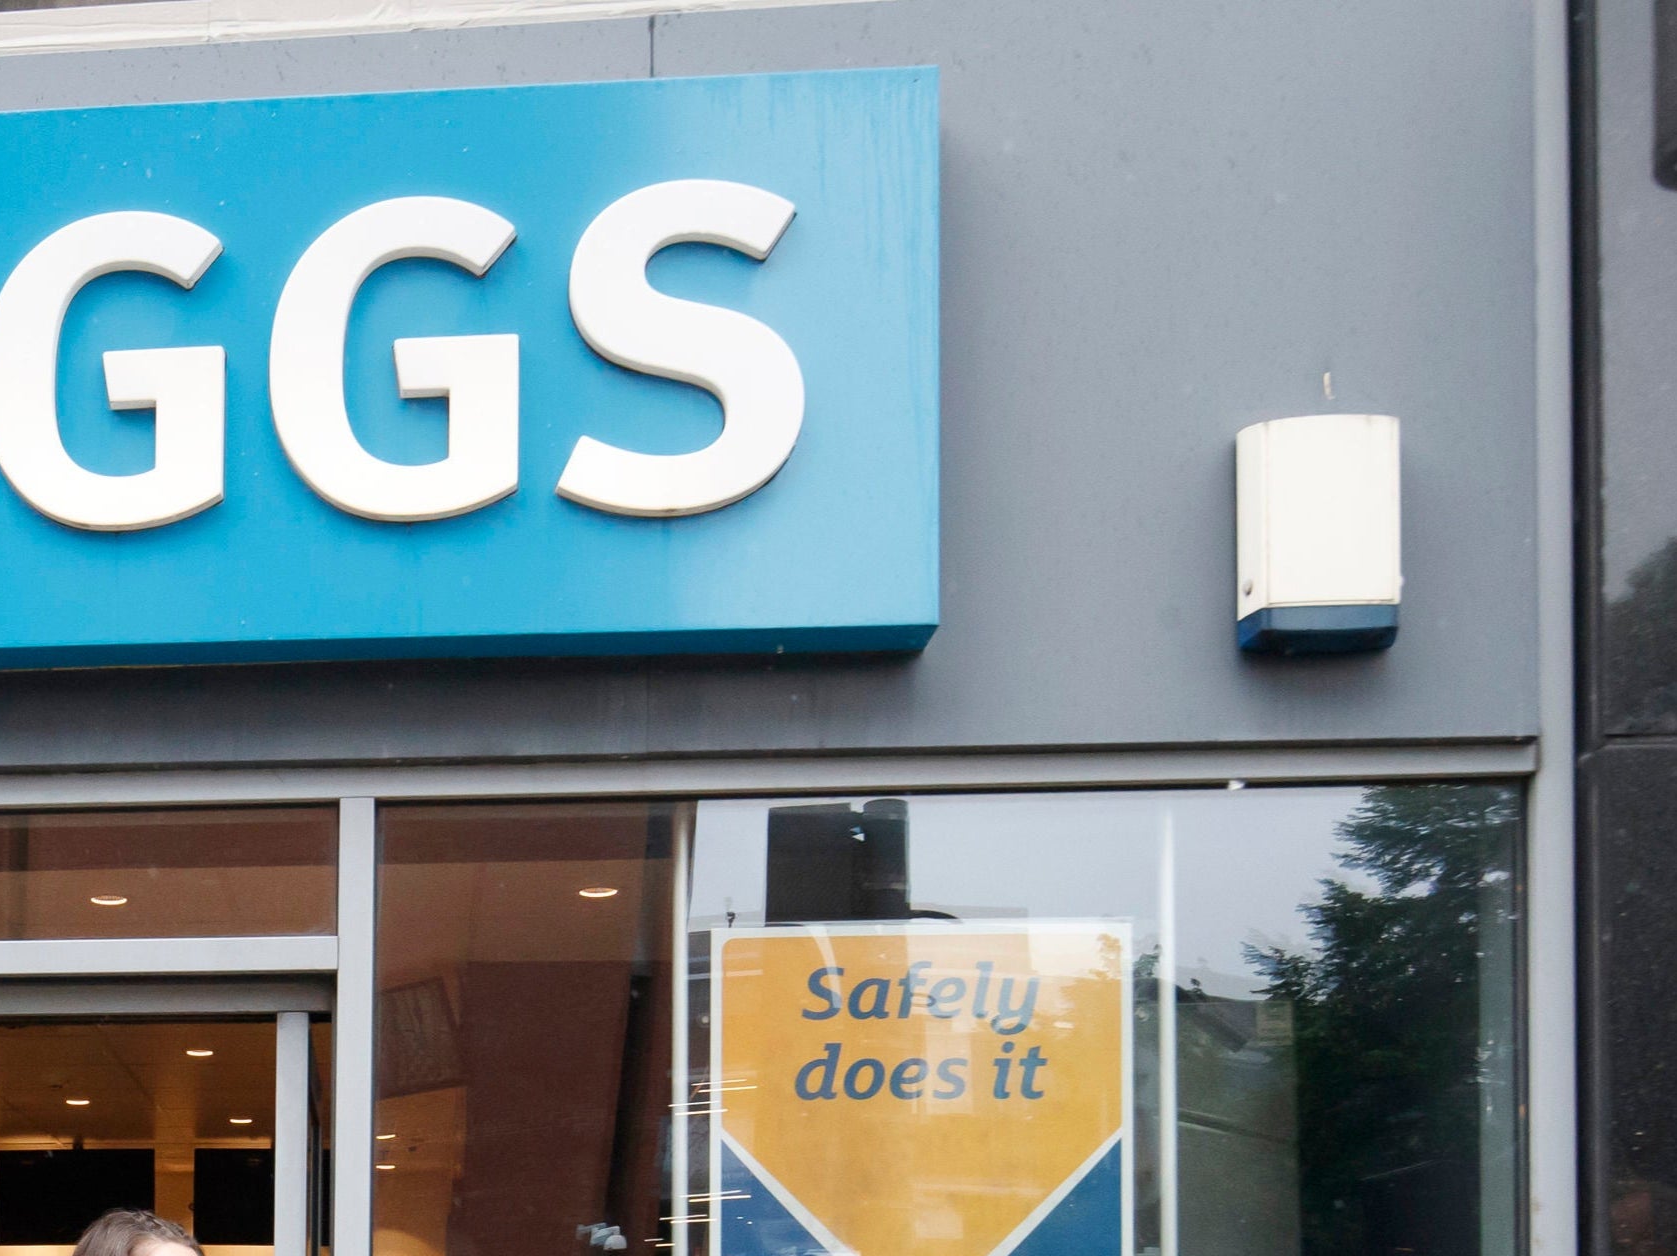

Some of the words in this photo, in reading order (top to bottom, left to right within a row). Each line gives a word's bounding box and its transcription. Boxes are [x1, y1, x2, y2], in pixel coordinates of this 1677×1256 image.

[801, 961, 1039, 1035] Safely
[794, 1042, 968, 1101] does
[992, 1042, 1048, 1100] it
